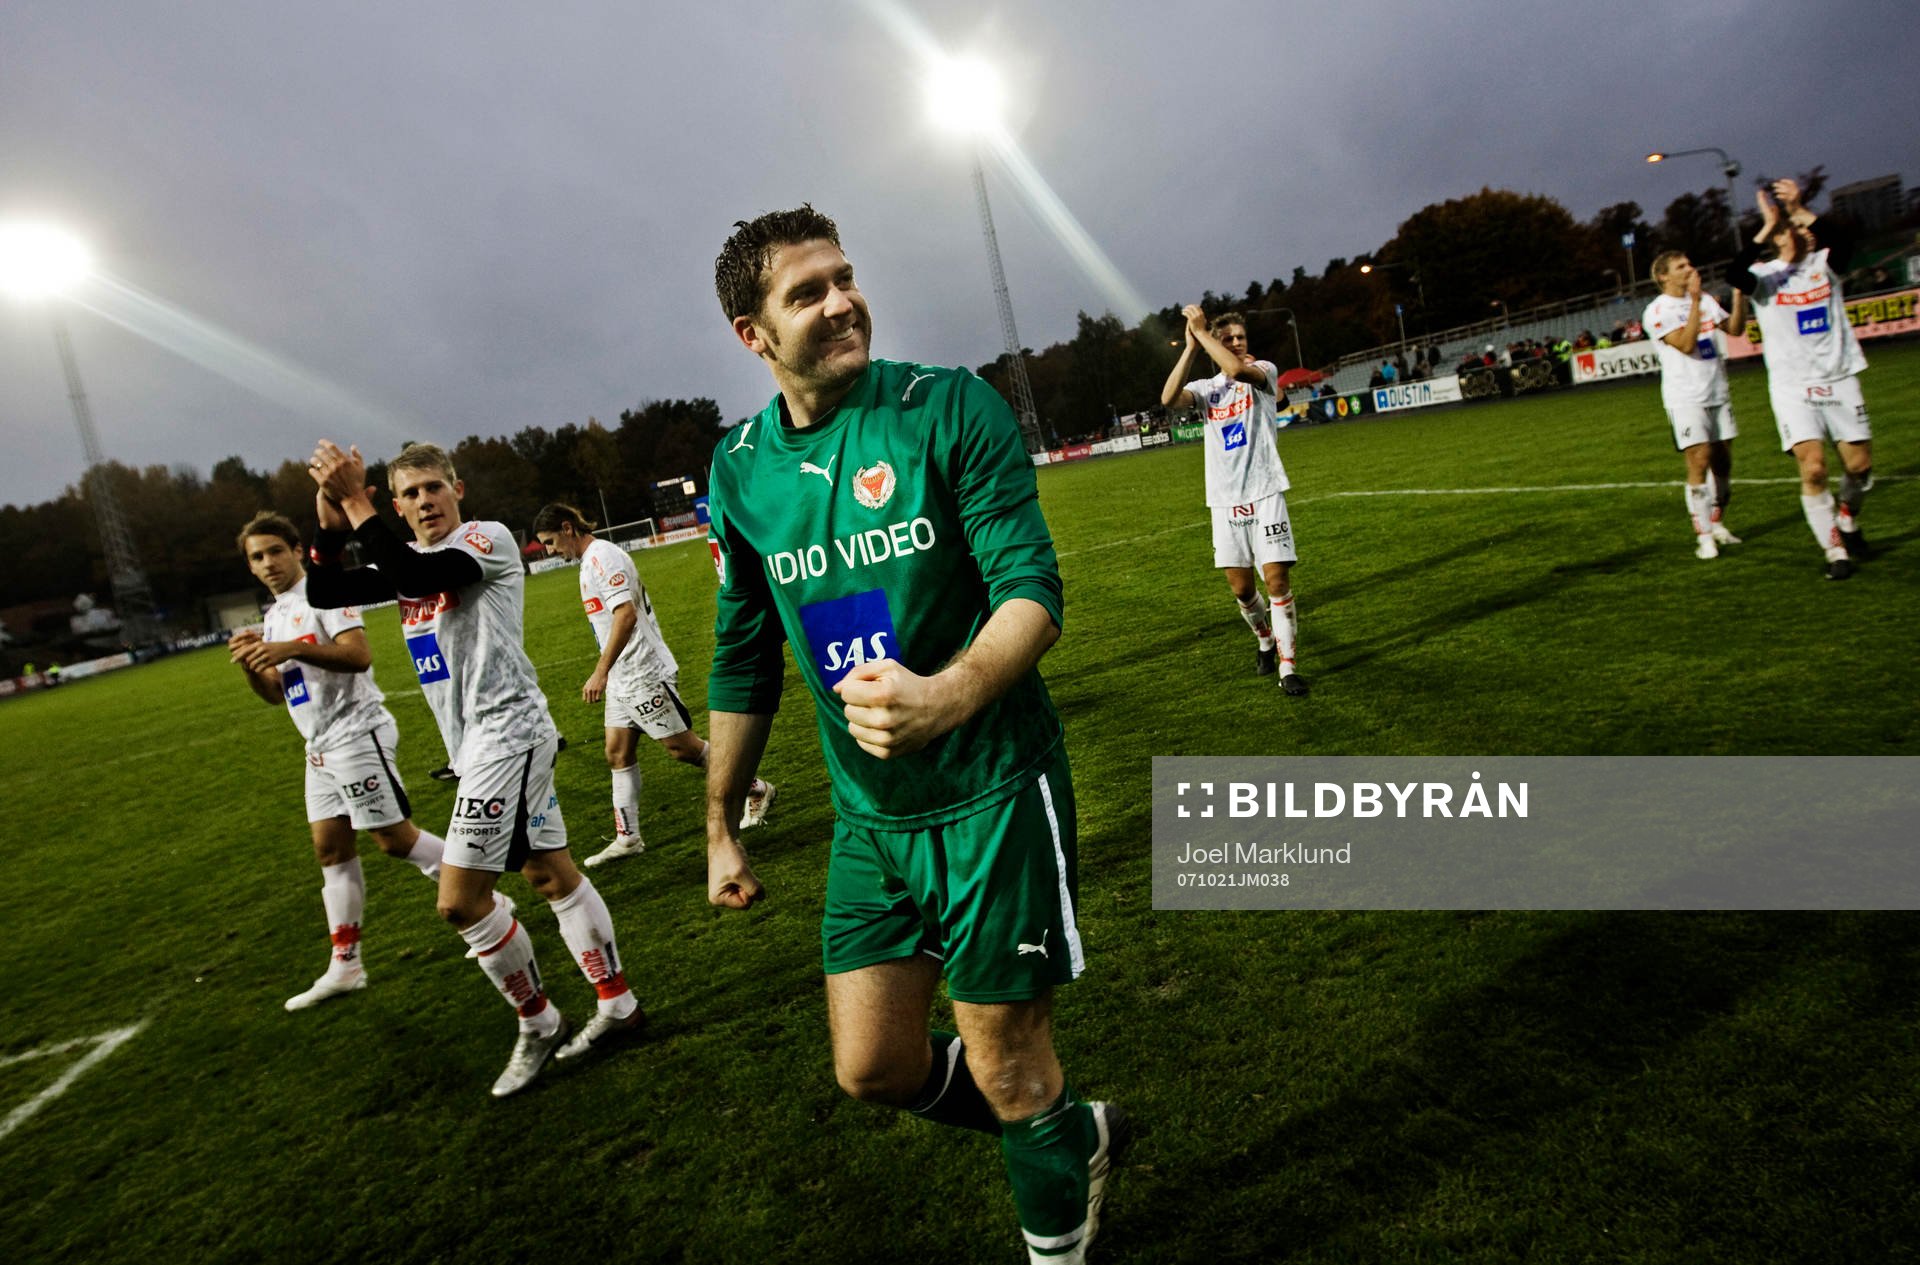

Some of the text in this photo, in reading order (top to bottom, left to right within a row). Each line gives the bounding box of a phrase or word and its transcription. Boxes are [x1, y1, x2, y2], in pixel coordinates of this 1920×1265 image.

[1844, 294, 1918, 327] SPORT
[1600, 354, 1661, 377] SVENSK
[1389, 383, 1431, 408] DUSTIN
[1264, 521, 1289, 537] IEC
[834, 517, 936, 569] VIDEO
[824, 632, 887, 671] SAS
[416, 654, 441, 674] SAS
[635, 694, 665, 716] IEC
[342, 775, 380, 799] IEC
[456, 797, 505, 819] IEC
[459, 826, 501, 836] SPORTS
